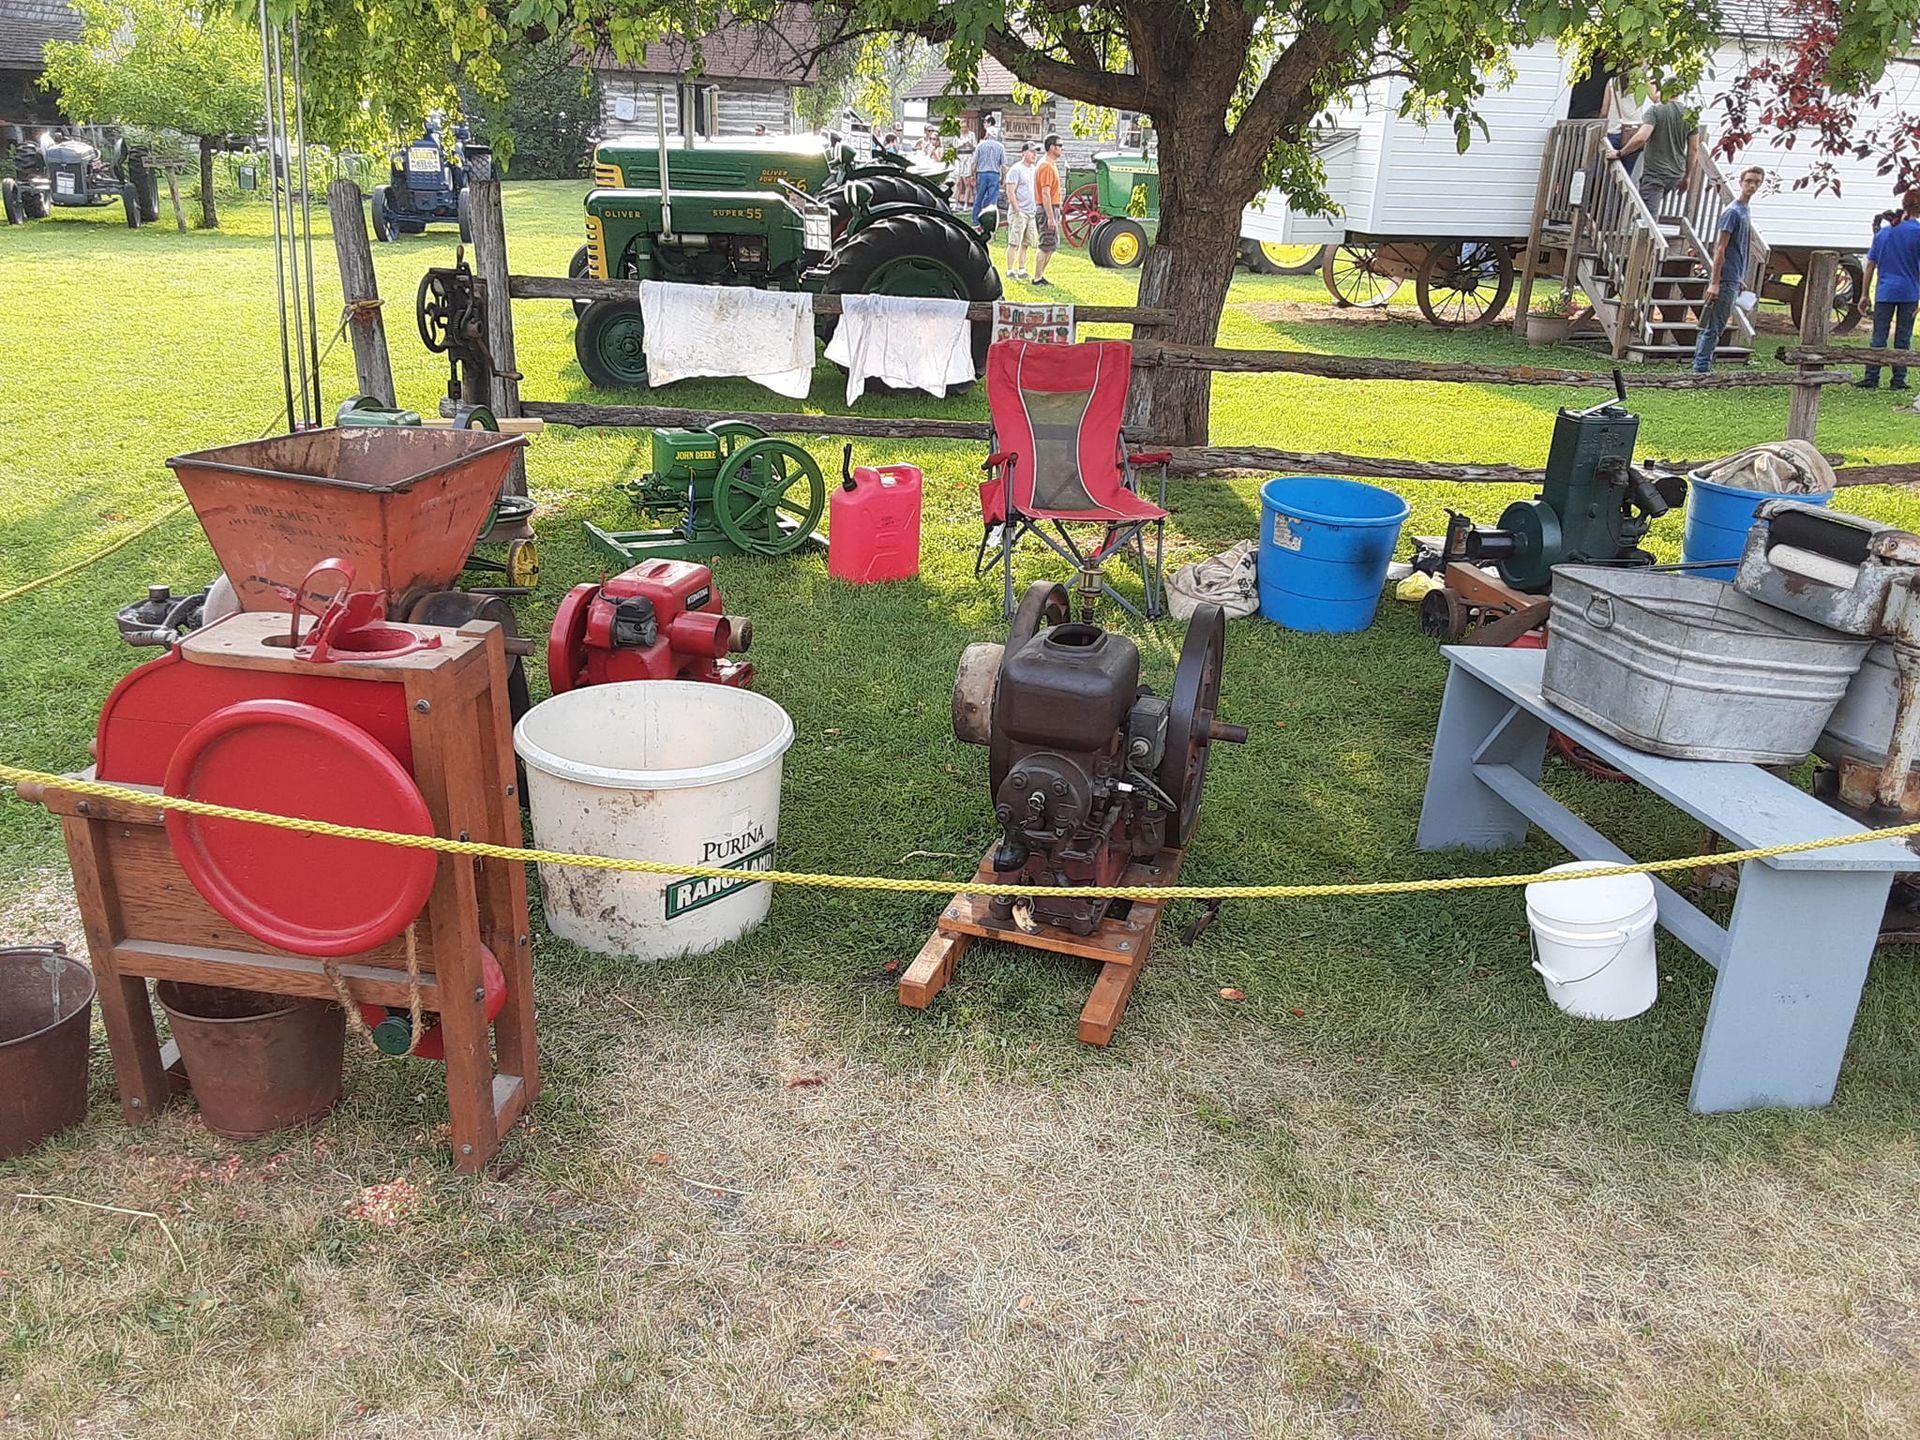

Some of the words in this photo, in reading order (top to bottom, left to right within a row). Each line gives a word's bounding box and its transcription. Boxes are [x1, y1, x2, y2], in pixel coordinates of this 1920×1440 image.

[604, 210, 641, 218] OLIVER
[712, 209, 744, 217] SUPER
[746, 207, 763, 219] 55
[675, 451, 694, 460] JOHN
[695, 450, 716, 460] DEERE
[702, 823, 765, 862] PURINA
[676, 853, 772, 910] RANGELAND
